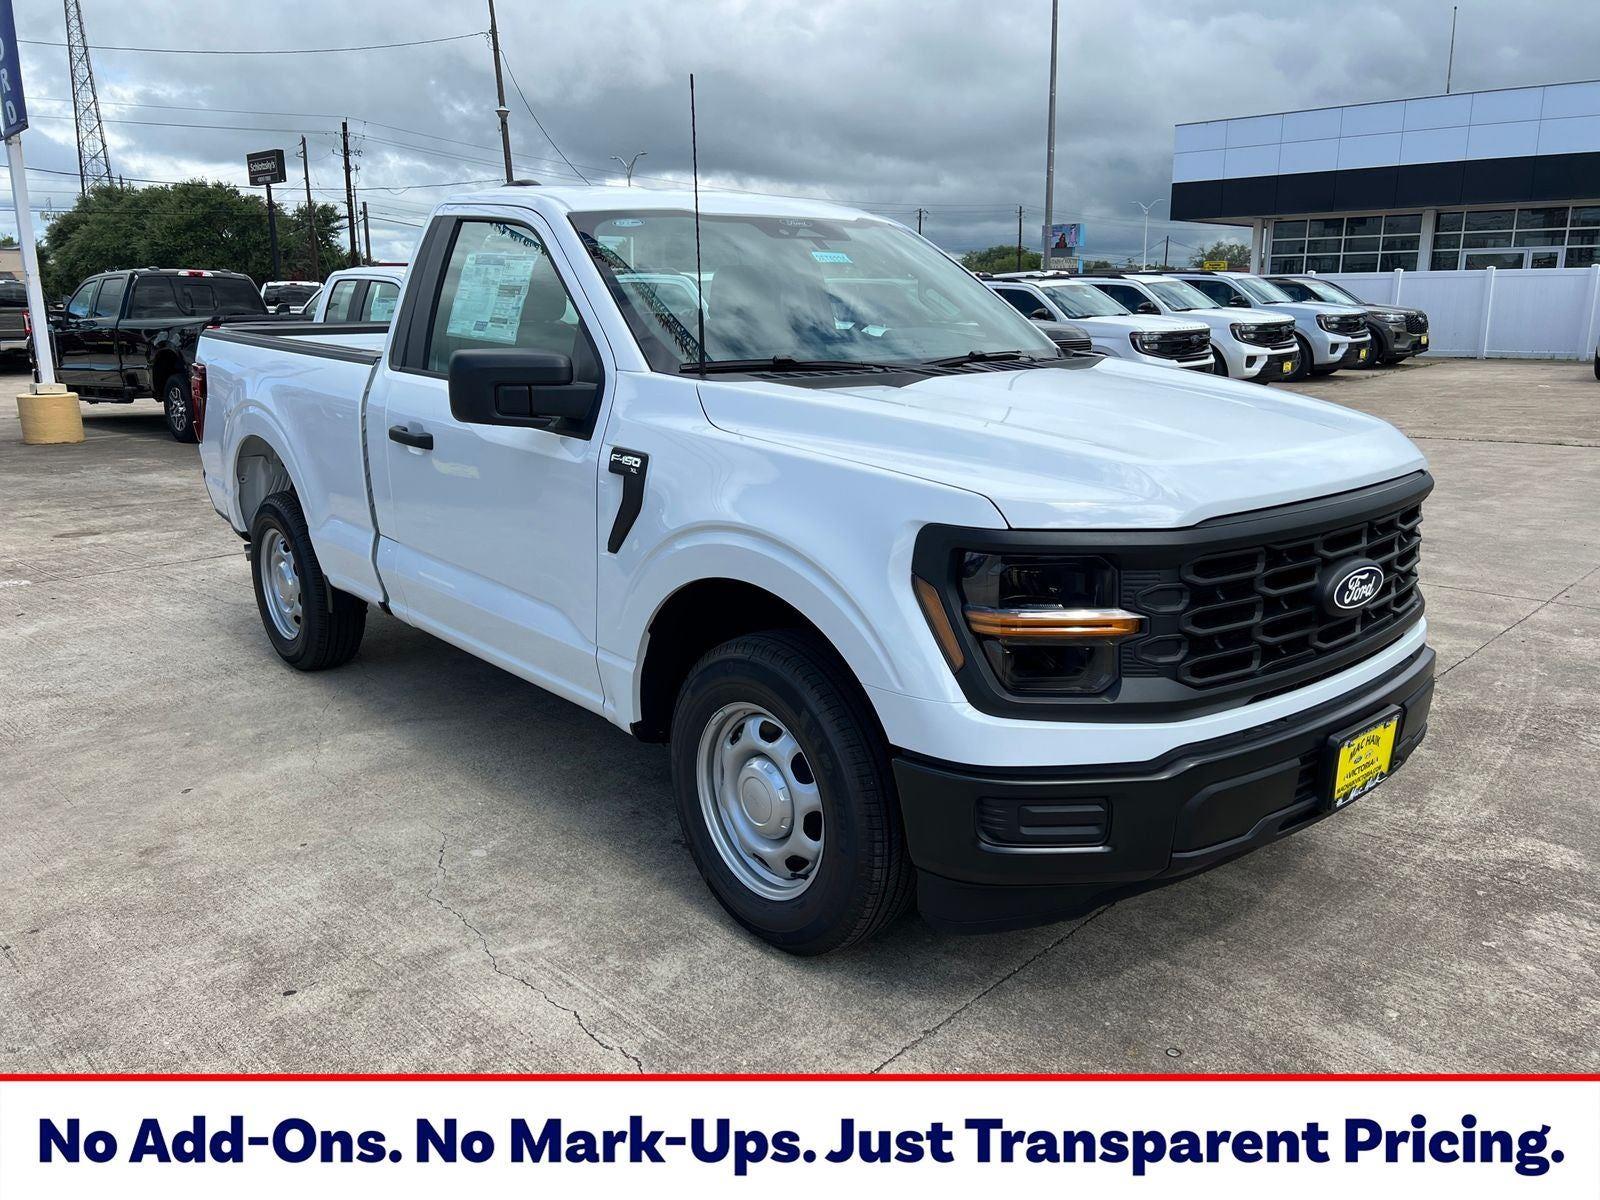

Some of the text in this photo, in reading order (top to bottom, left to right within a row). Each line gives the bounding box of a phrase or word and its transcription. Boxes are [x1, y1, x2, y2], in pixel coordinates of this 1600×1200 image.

[610, 453, 642, 468] F-150
[1343, 572, 1376, 604] Ford
[1349, 738, 1366, 761] MAC
